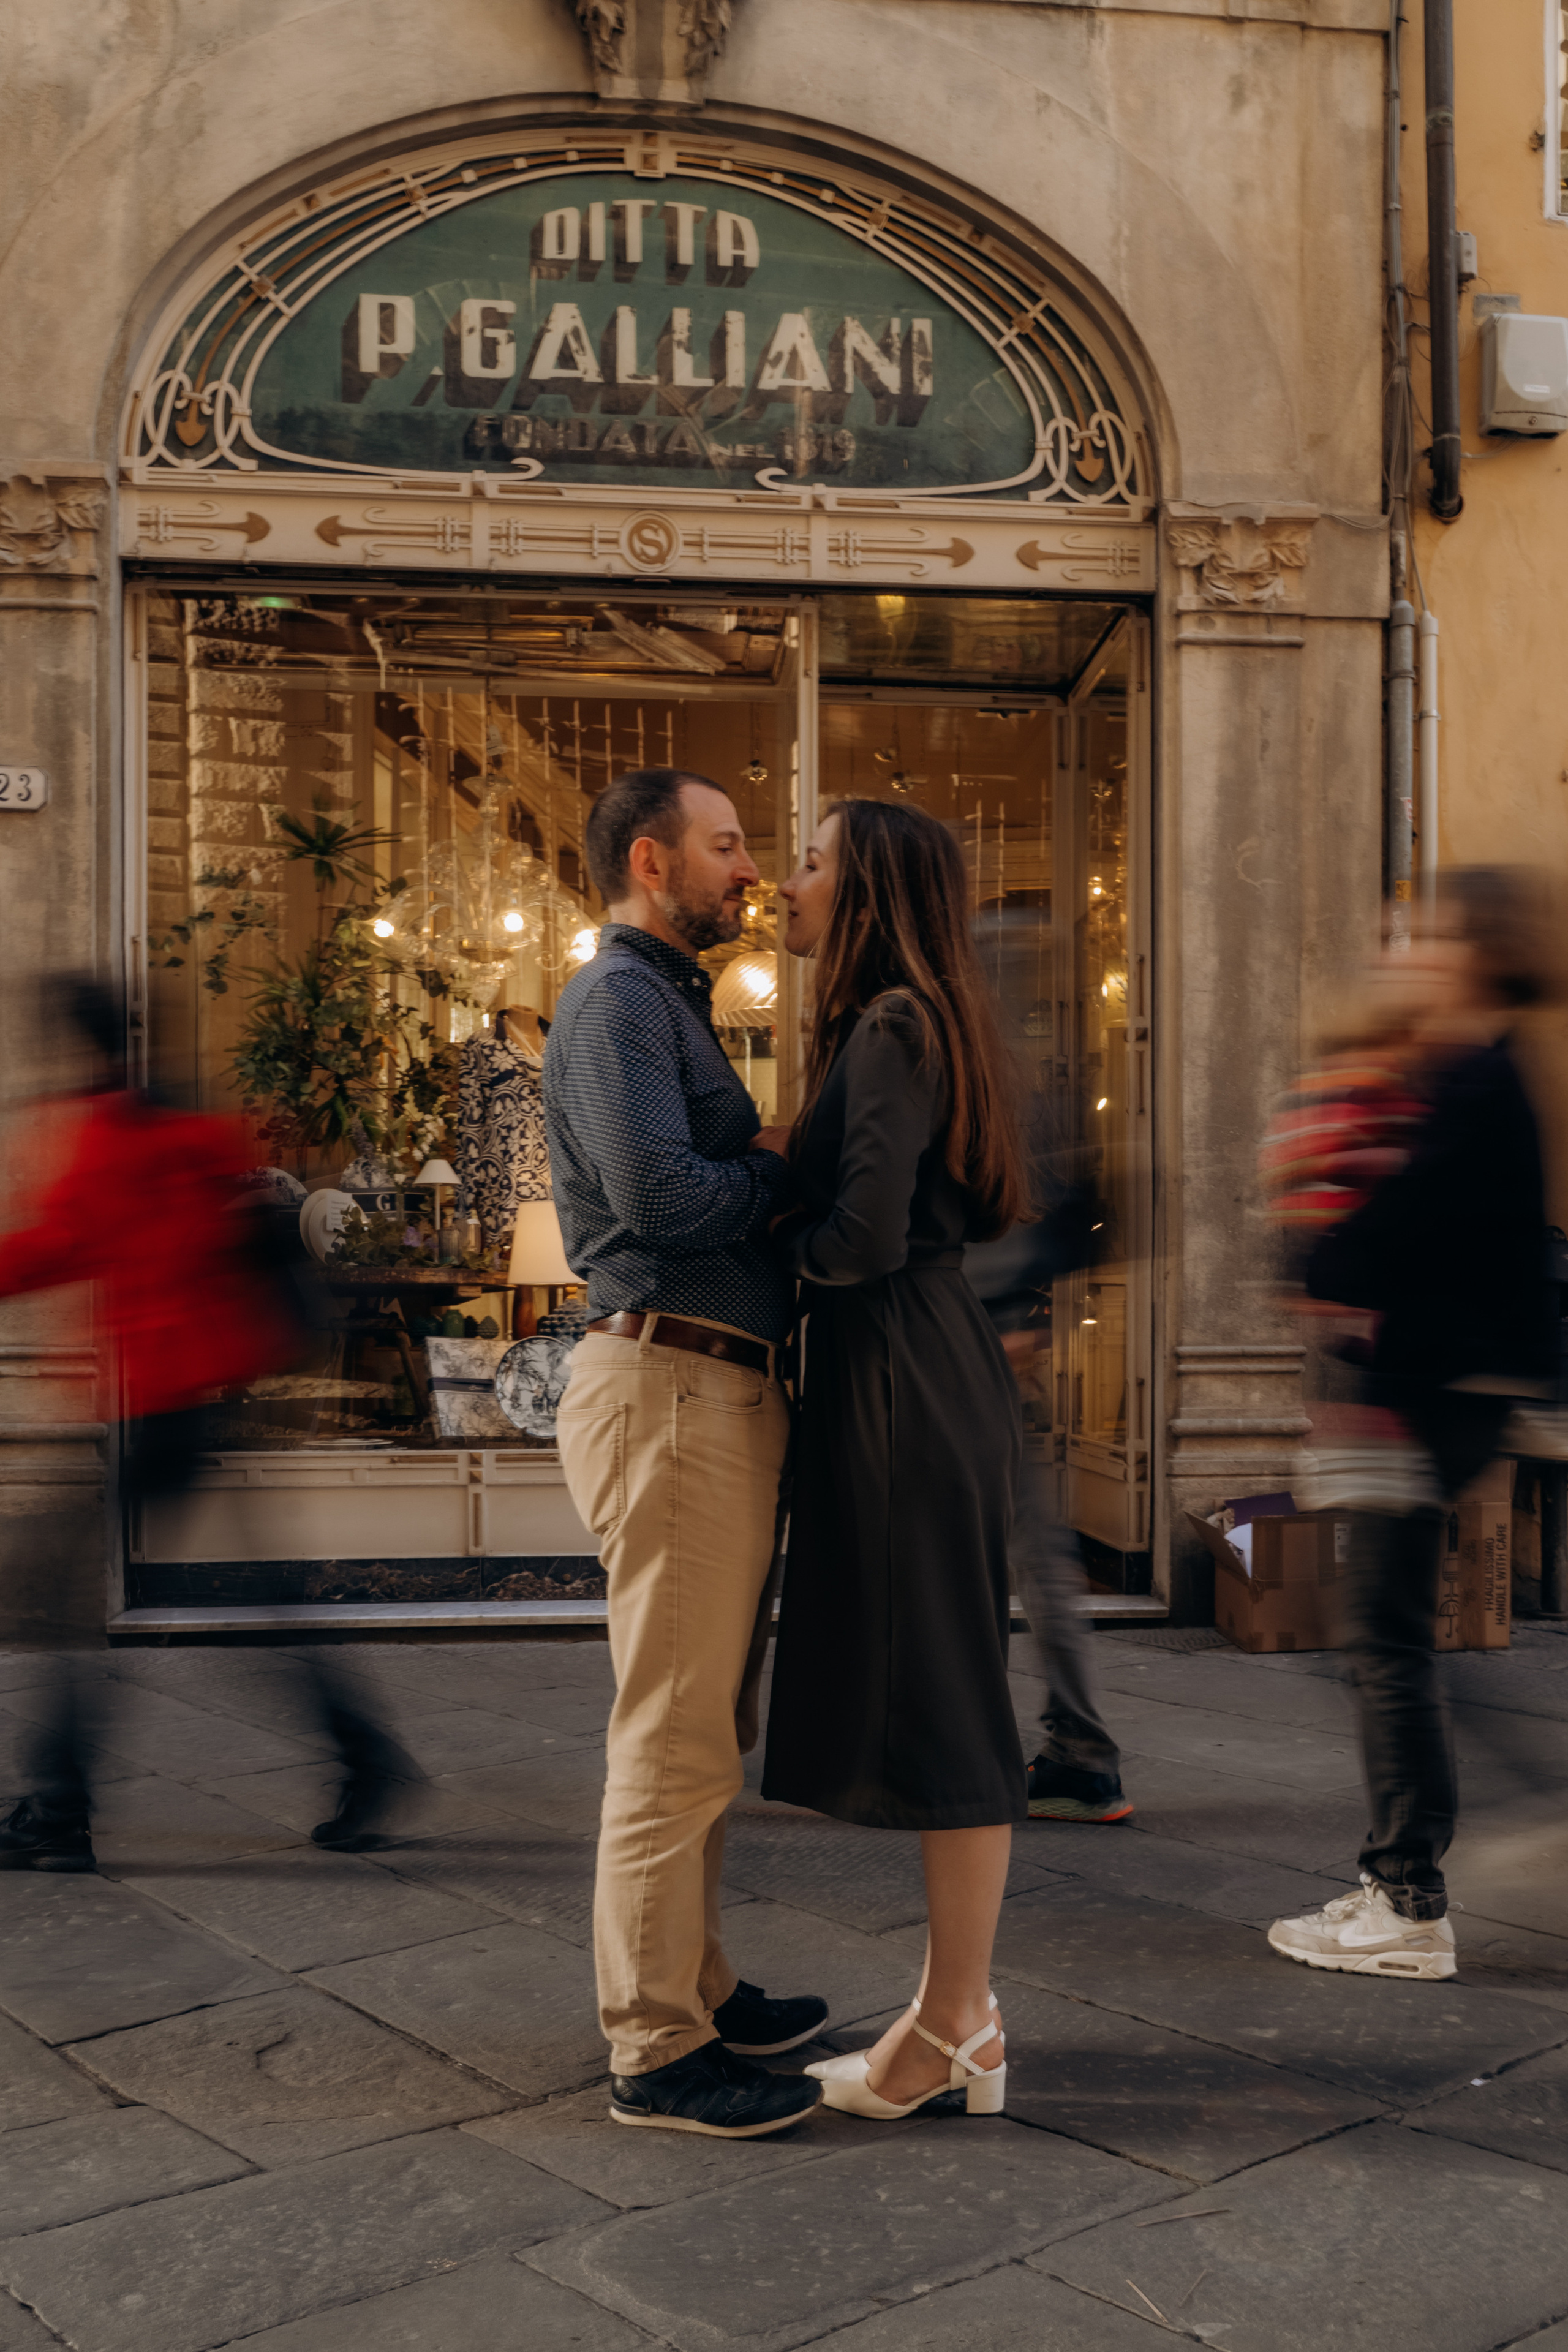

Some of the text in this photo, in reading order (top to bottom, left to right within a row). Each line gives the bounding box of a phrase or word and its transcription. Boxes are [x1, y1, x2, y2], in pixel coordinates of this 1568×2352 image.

[542, 199, 760, 268] DITTA
[375, 1194, 391, 1211] G
[1484, 1537, 1495, 1611] FRAGILISSIMO
[1495, 1523, 1507, 1625] HANDLE WITH CARE
